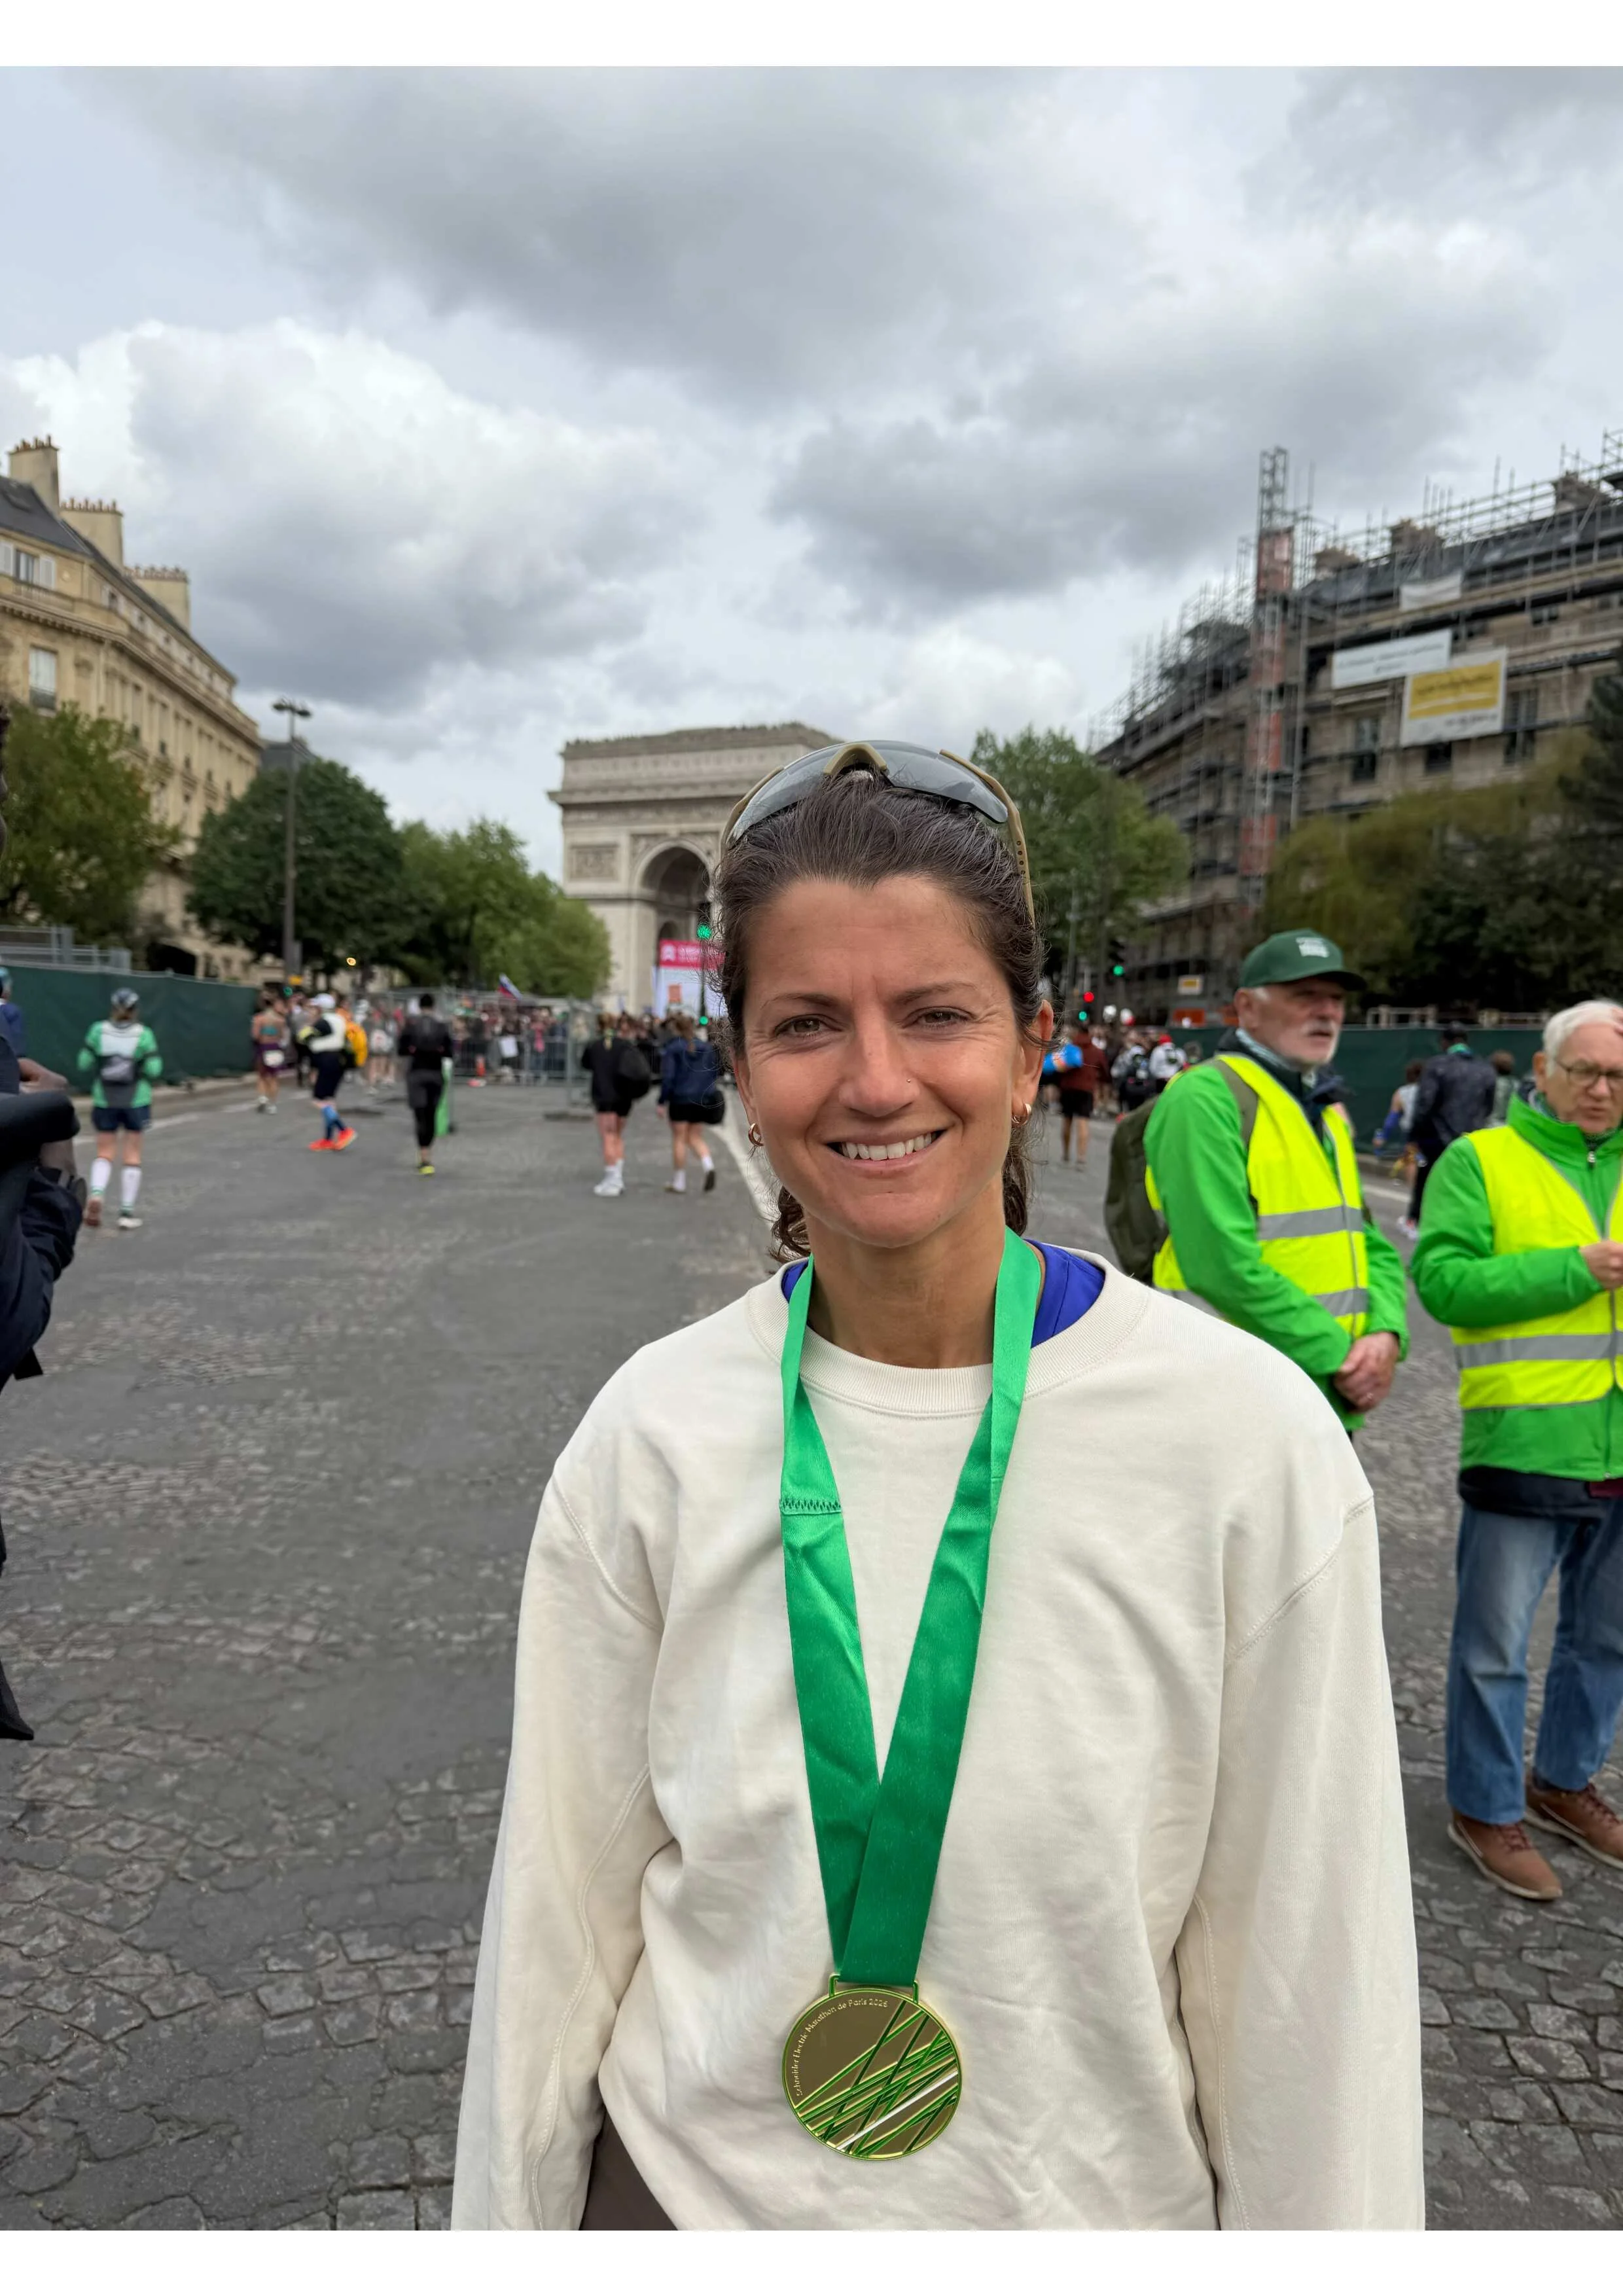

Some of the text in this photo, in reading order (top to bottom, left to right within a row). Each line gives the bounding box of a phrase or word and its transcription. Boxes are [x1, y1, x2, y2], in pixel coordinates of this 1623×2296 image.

[804, 2006, 837, 2032] Marathon
[837, 2001, 847, 2011] de
[848, 1998, 867, 2007] Paris
